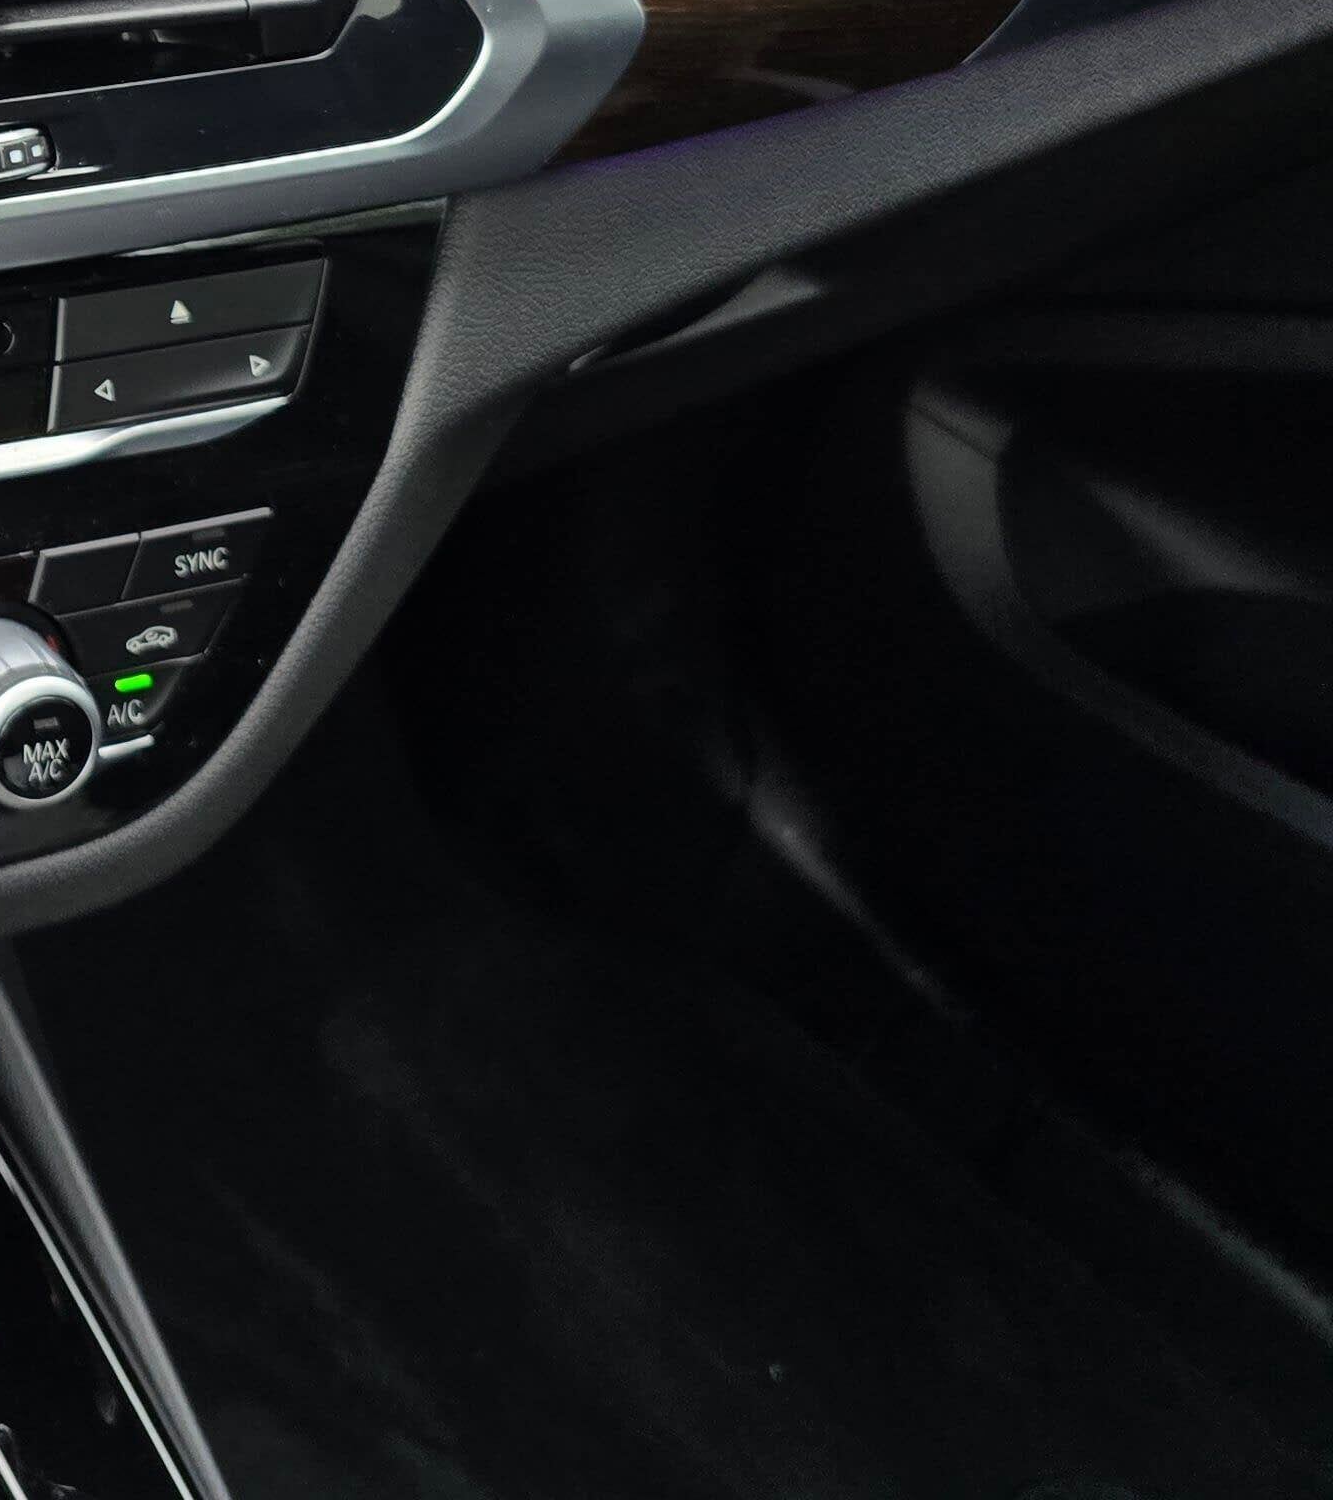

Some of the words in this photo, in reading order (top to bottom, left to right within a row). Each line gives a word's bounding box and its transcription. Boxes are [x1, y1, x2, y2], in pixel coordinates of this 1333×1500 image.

[174, 546, 229, 578] SYNC
[106, 698, 144, 727] A/C
[23, 737, 70, 765] MAX
[28, 759, 63, 784] A/C
